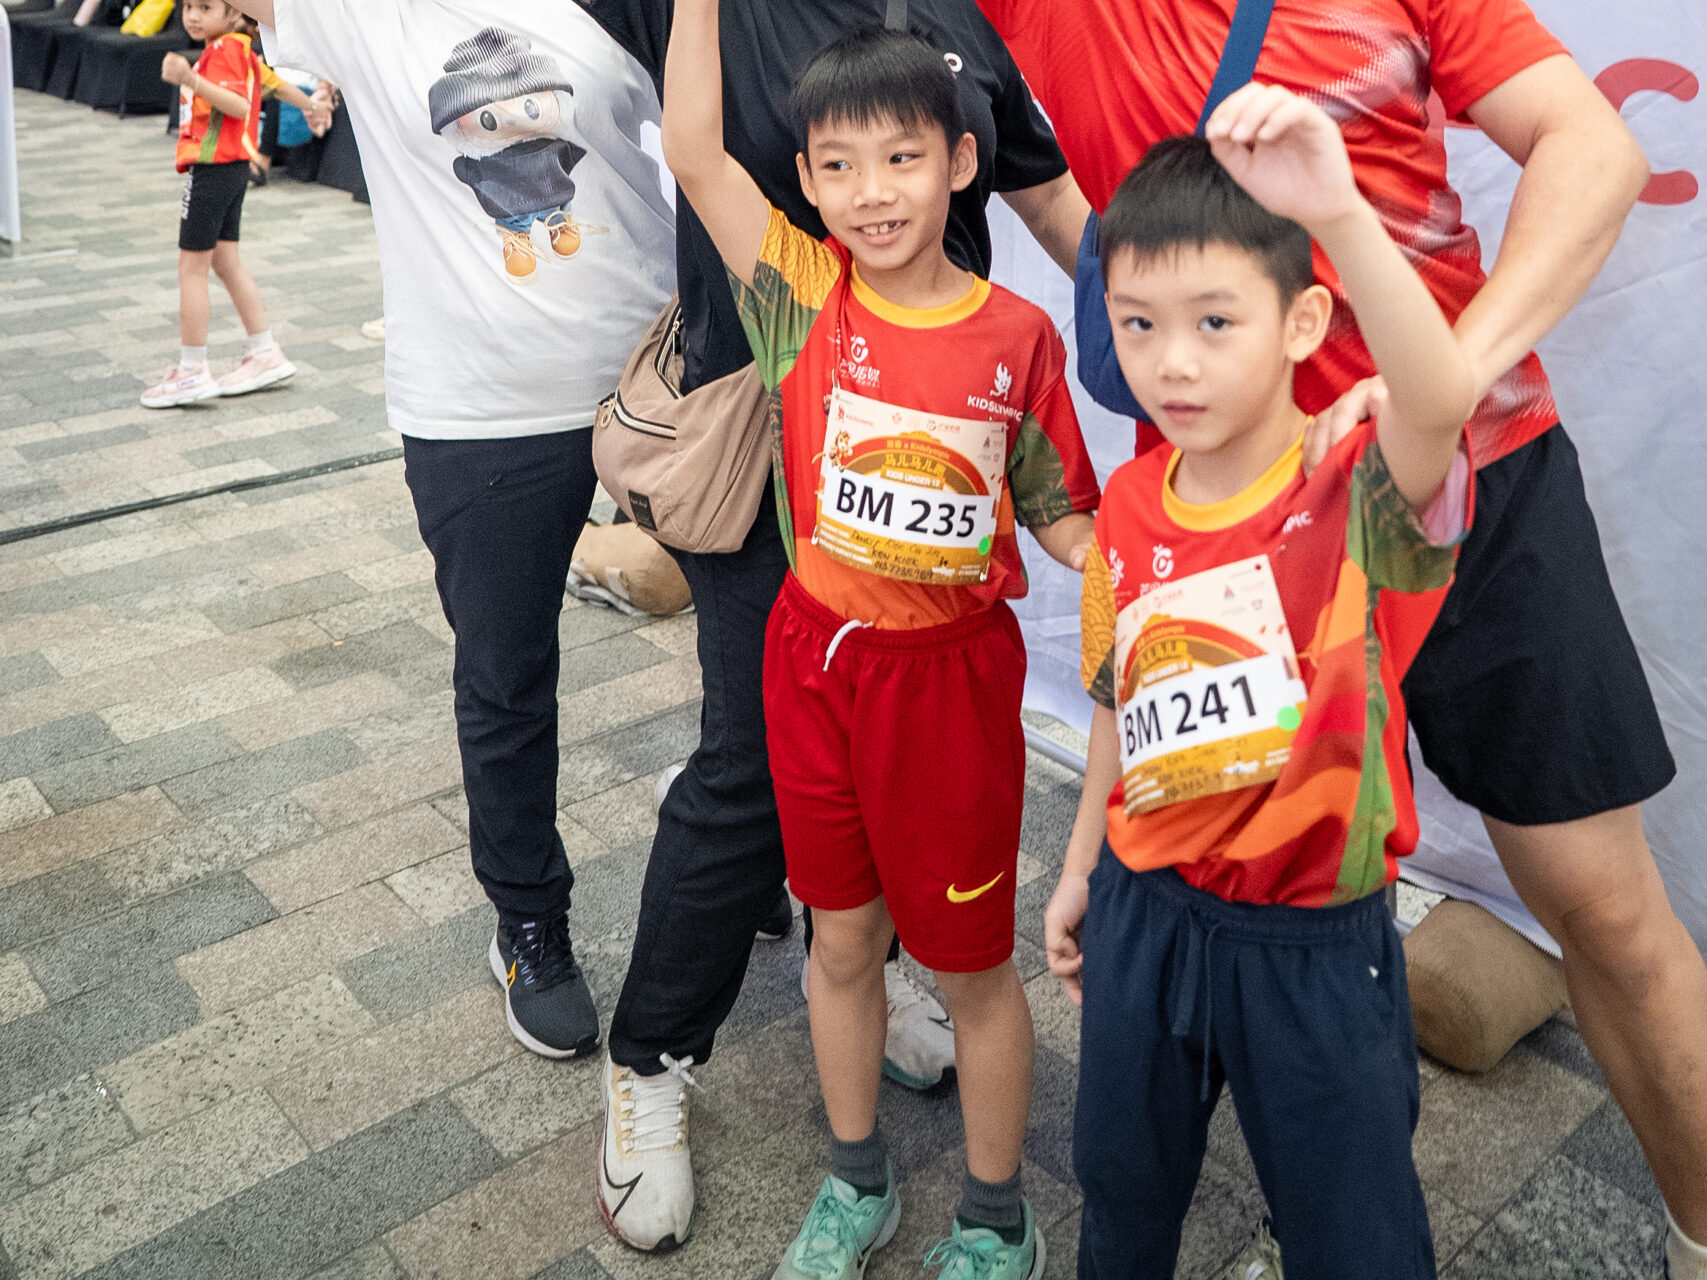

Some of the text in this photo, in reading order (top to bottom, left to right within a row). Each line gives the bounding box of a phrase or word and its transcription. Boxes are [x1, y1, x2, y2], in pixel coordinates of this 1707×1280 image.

[836, 477, 977, 538] BM 235
[1124, 675, 1257, 758] BM 241
